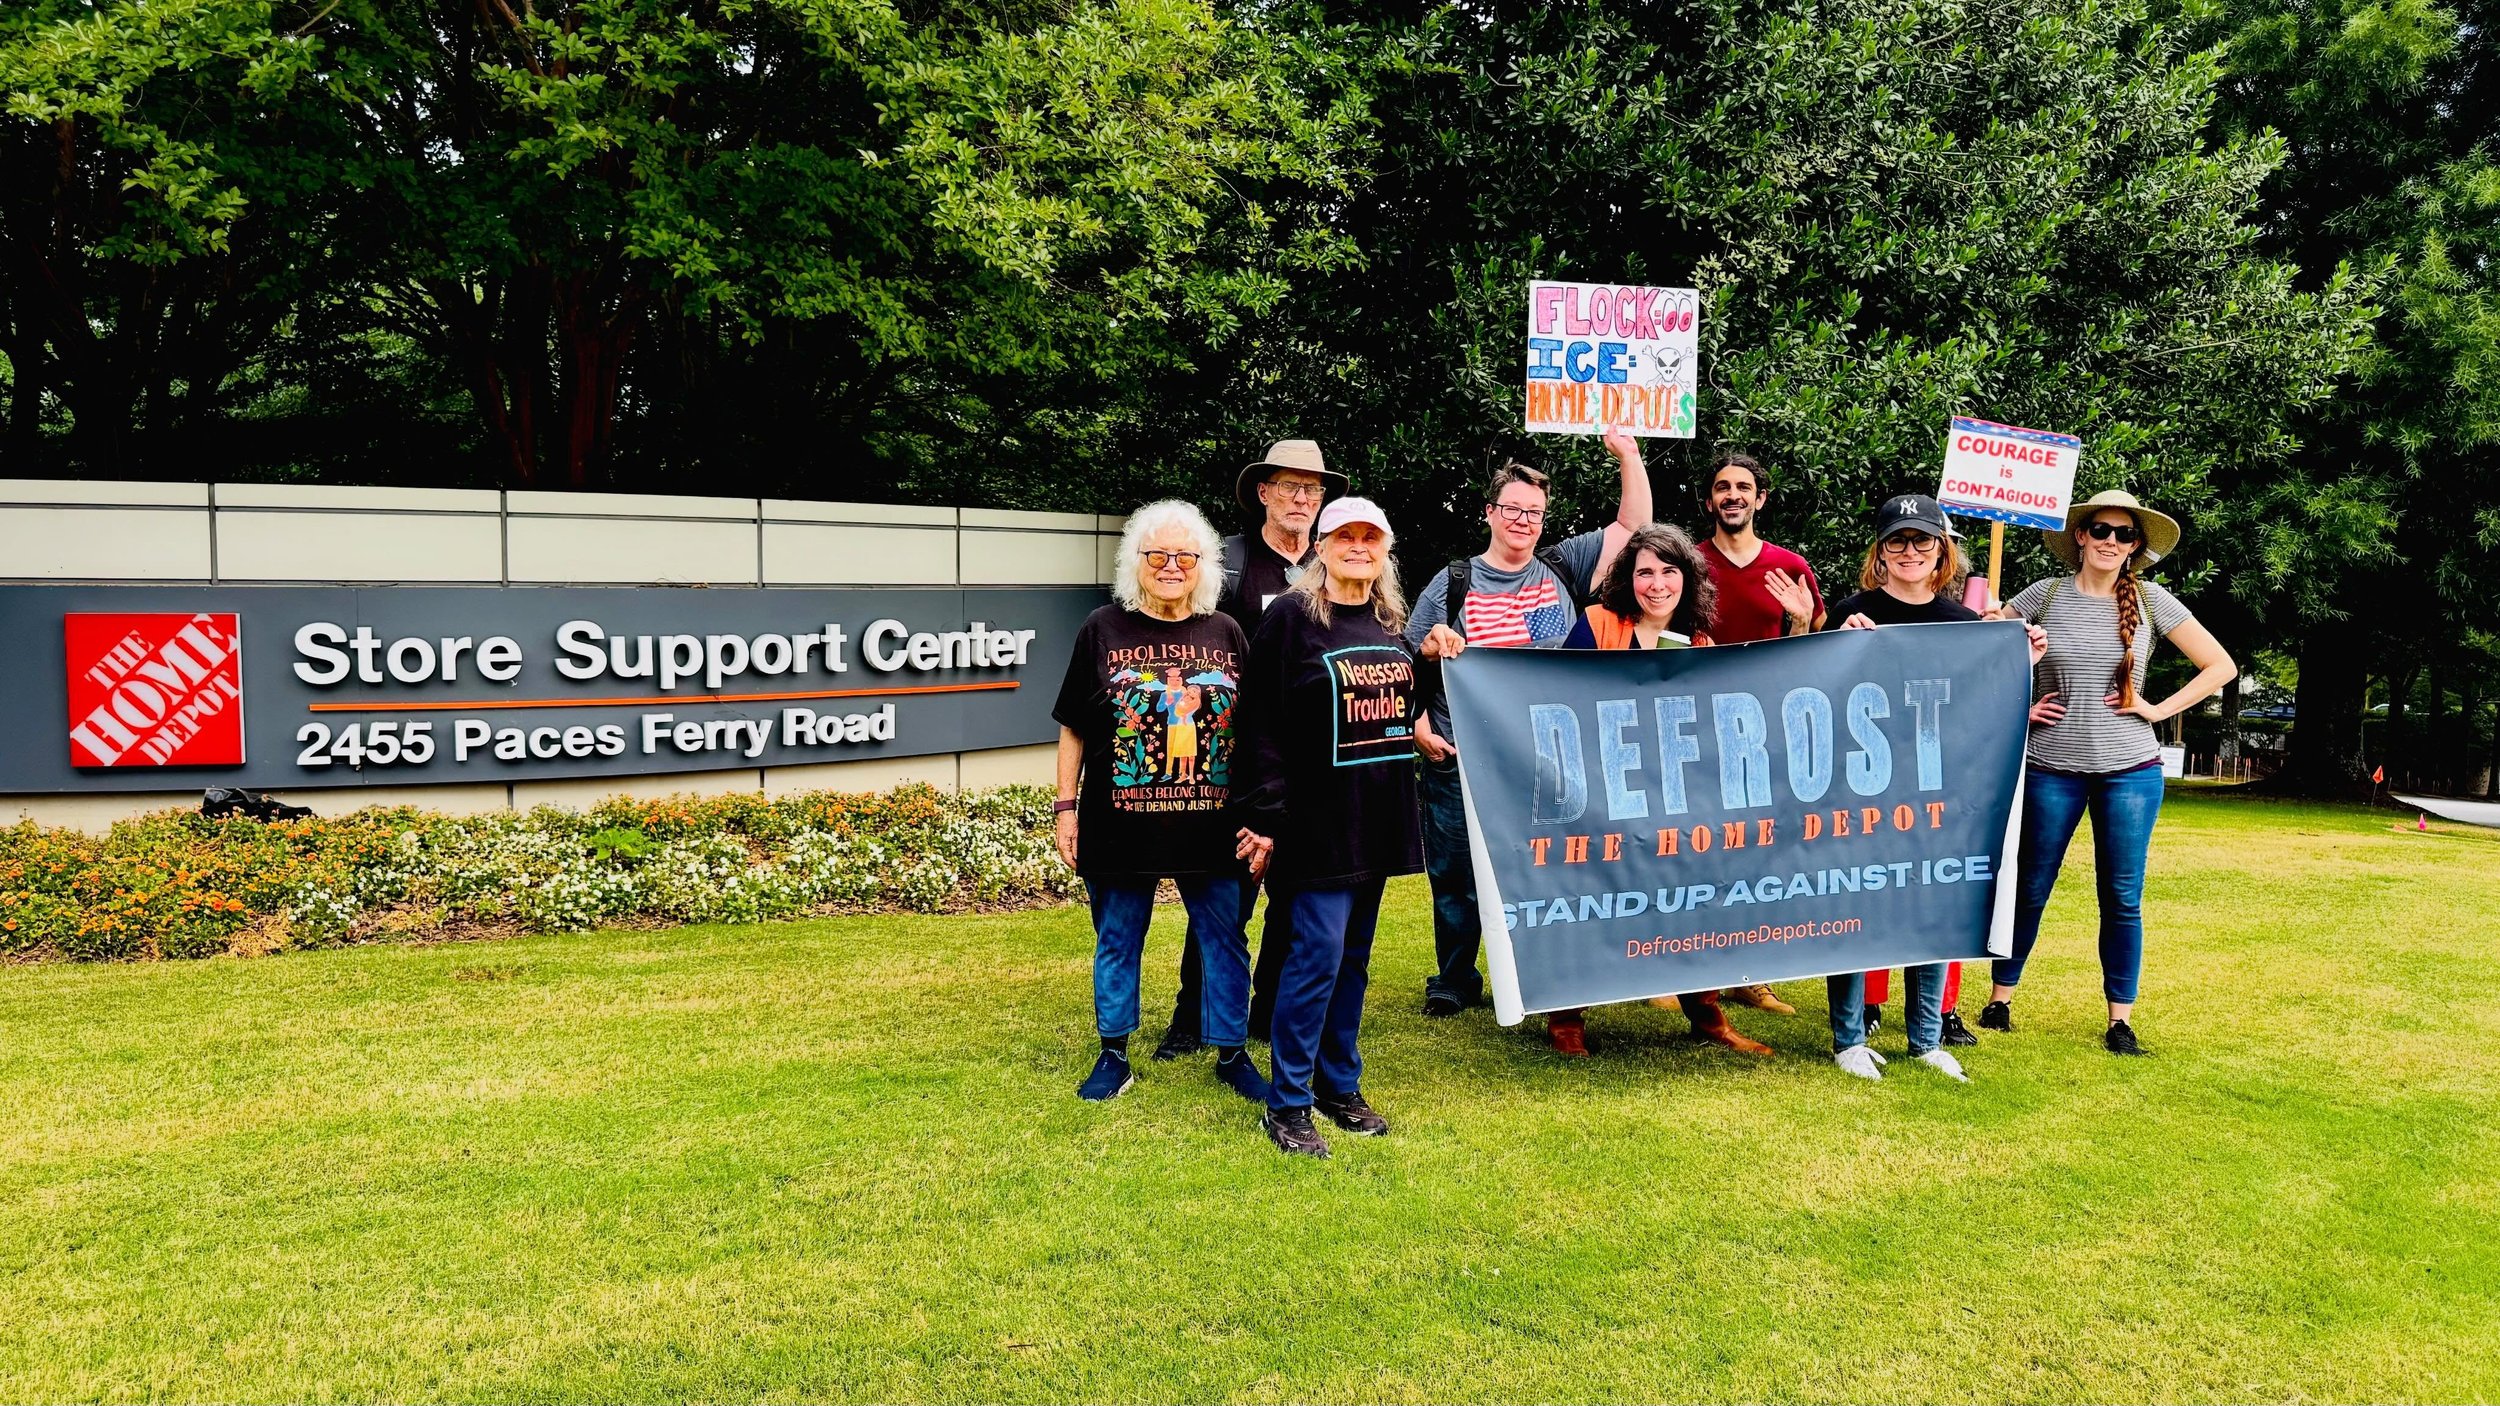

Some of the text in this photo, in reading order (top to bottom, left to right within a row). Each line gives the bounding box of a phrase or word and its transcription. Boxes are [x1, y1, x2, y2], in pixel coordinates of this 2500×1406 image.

[1528, 338, 1637, 384] ICE:
[1527, 382, 1594, 424] HOME
[1957, 435, 2059, 467] COURAGE
[1999, 465, 2013, 479] is
[1946, 480, 2057, 510] CONTAGIOUS
[84, 629, 155, 691] THE
[293, 618, 1036, 690] Store Support Center
[1107, 644, 1196, 666] ABOLISH
[1139, 657, 1178, 672] Human
[1179, 657, 1193, 670] Is
[70, 613, 238, 766] HOME
[1343, 687, 1405, 723] Trouble
[138, 670, 240, 765] DEPOT
[296, 702, 897, 766] 2455 Paces Ferry Road
[1529, 677, 1951, 826] DEFROST
[1112, 788, 1152, 801] FAMILIES
[1155, 786, 1195, 799] BELONG
[1146, 801, 1185, 812] DEMAND
[1530, 802, 1946, 867] THE HOME DEPOT
[1656, 884, 1715, 914] UP
[1722, 861, 1913, 908] AGAINST
[1921, 855, 1994, 888] ICE
[1626, 917, 1862, 959] DefrostHomeDepot.com
